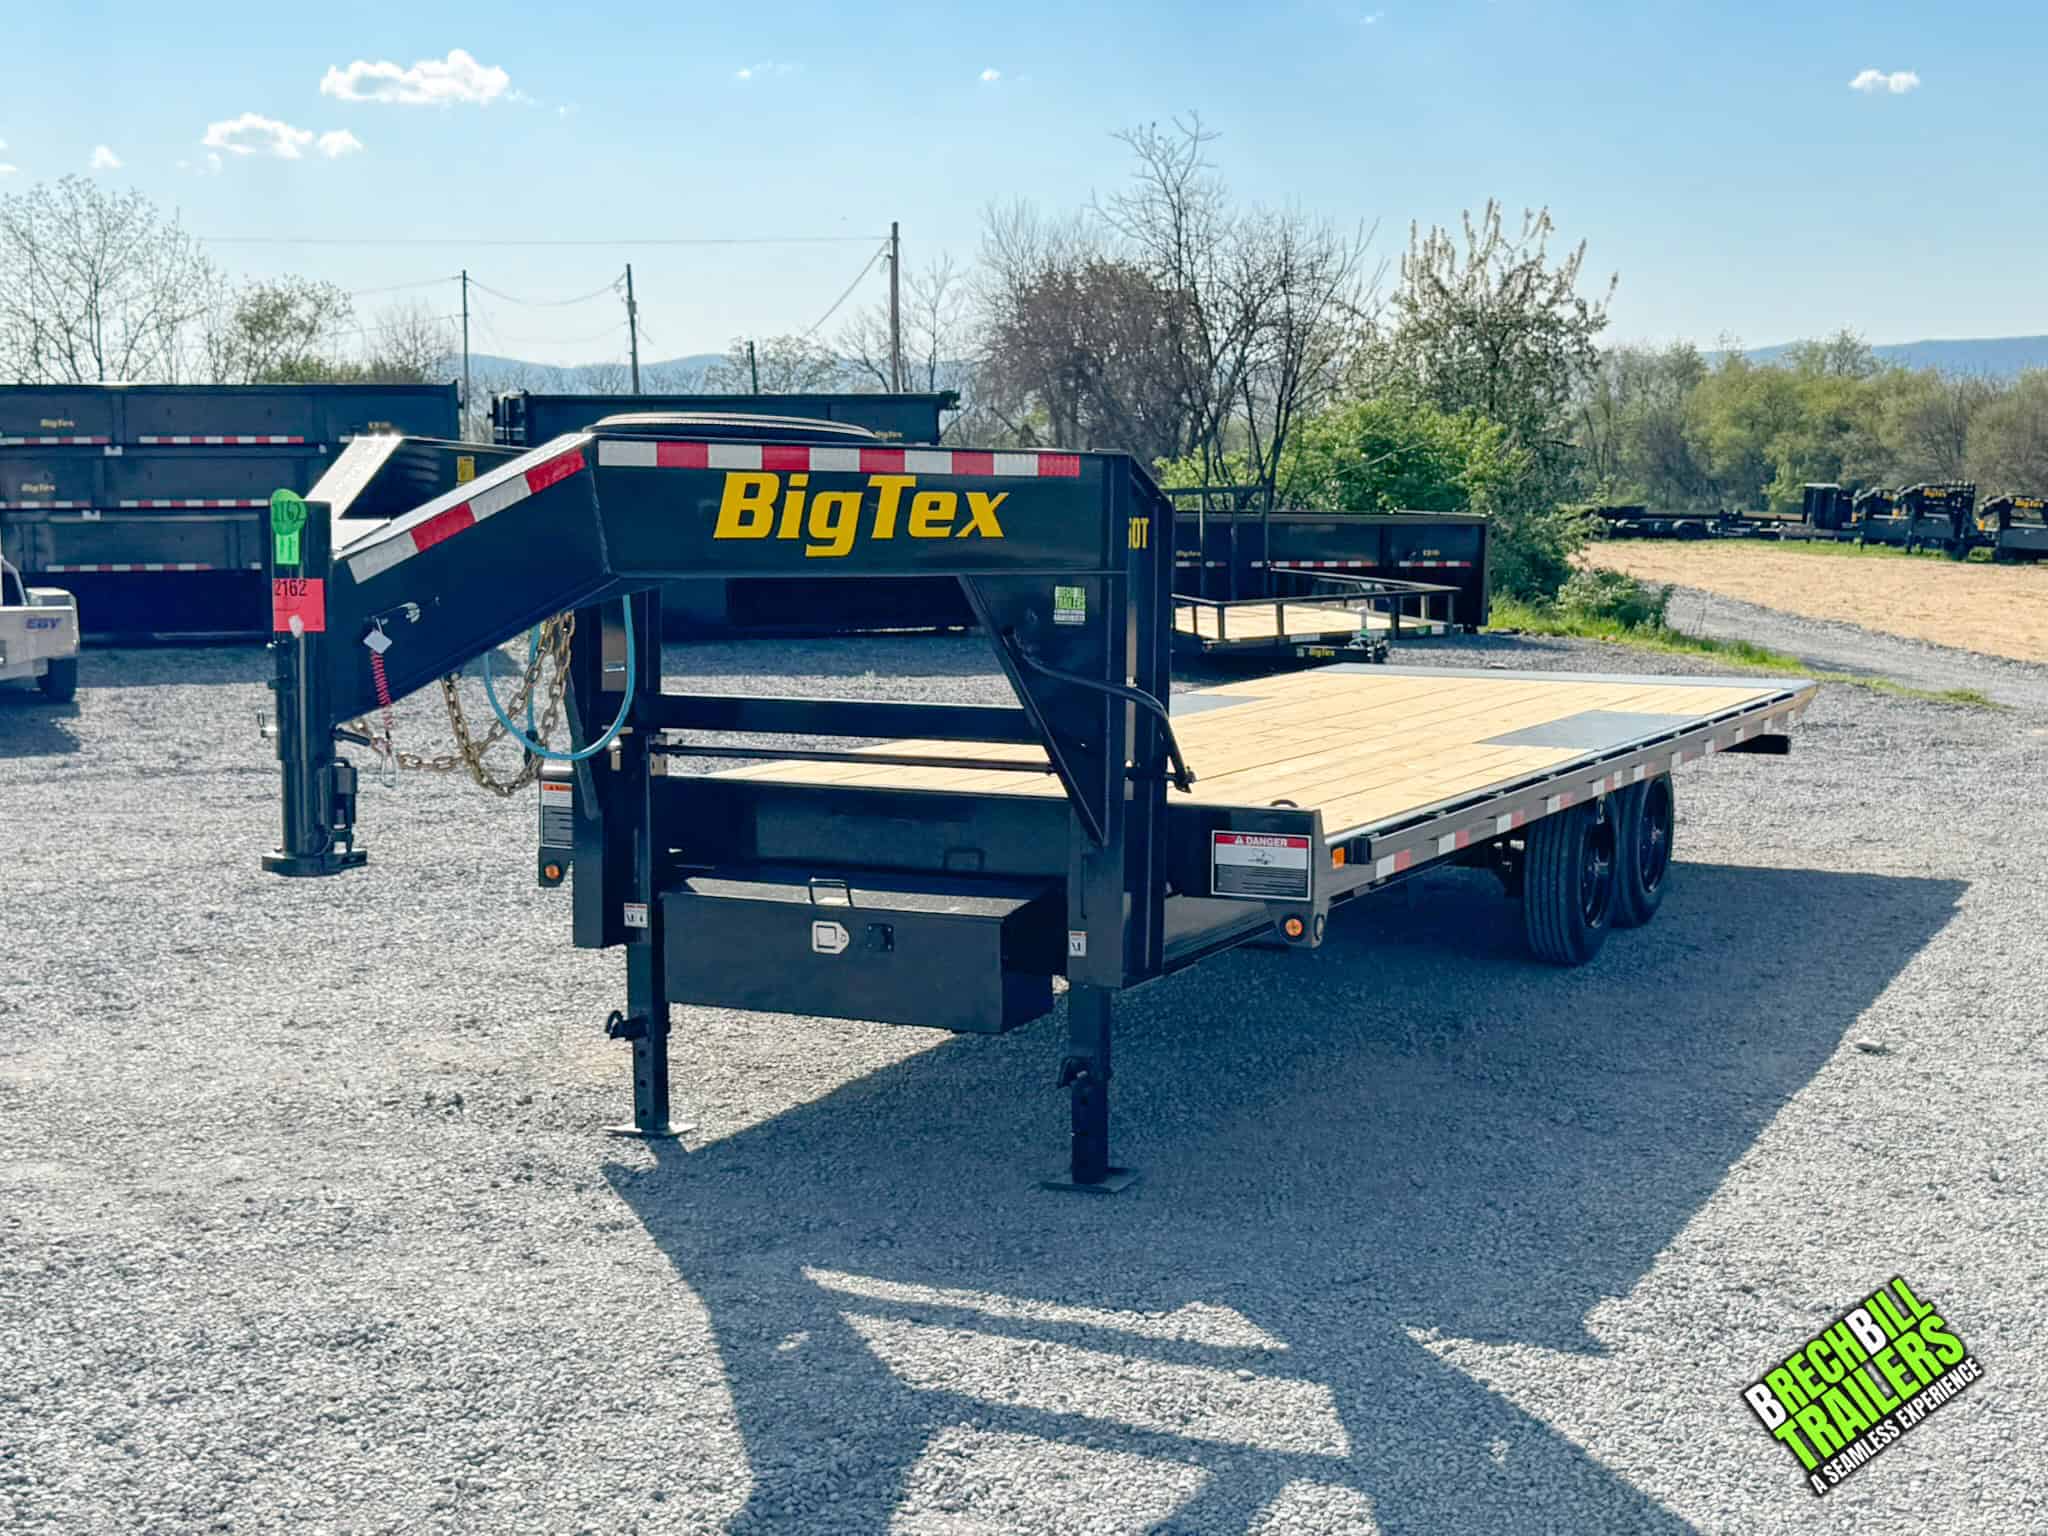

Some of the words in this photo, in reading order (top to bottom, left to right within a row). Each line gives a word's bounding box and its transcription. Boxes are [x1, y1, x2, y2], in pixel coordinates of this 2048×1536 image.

[713, 472, 1009, 558] BigTex
[273, 580, 307, 596] 2162
[1246, 836, 1288, 848] DANGER
